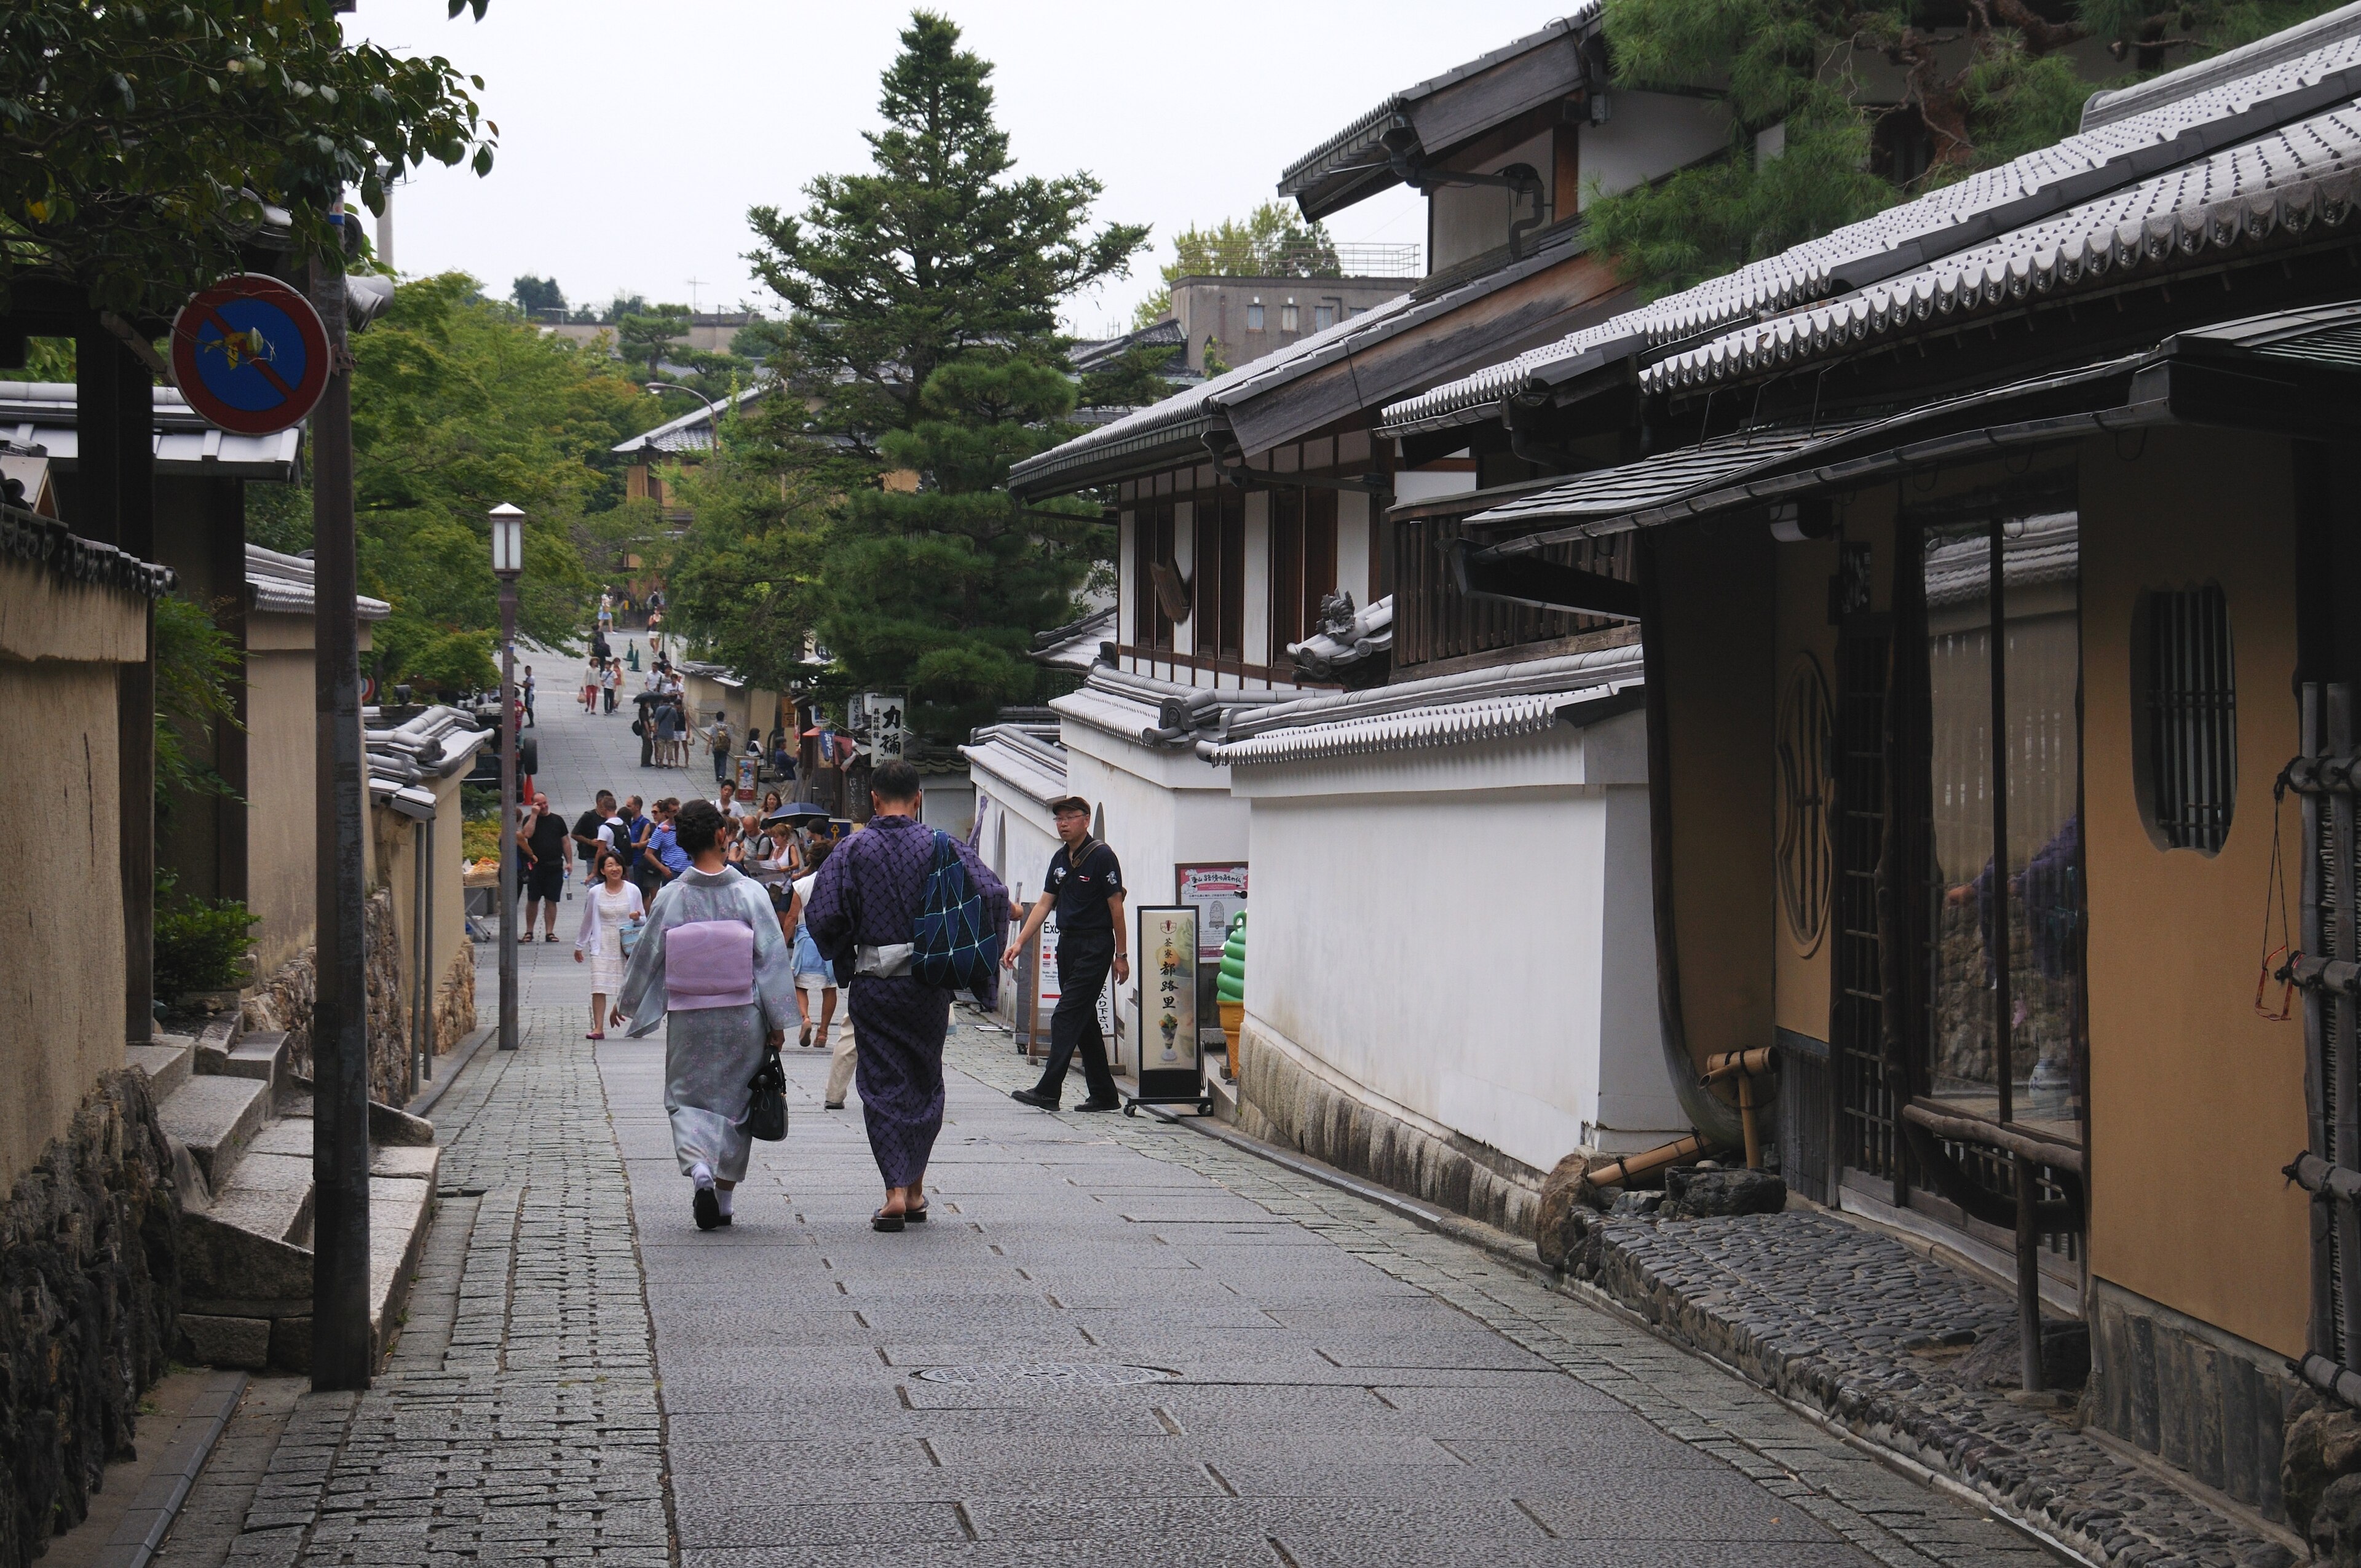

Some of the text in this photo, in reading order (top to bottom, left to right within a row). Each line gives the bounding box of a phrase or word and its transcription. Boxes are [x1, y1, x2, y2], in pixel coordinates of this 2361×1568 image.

[1044, 922, 1059, 934] Exc
[1097, 982, 1109, 1033] お入り下さい。
